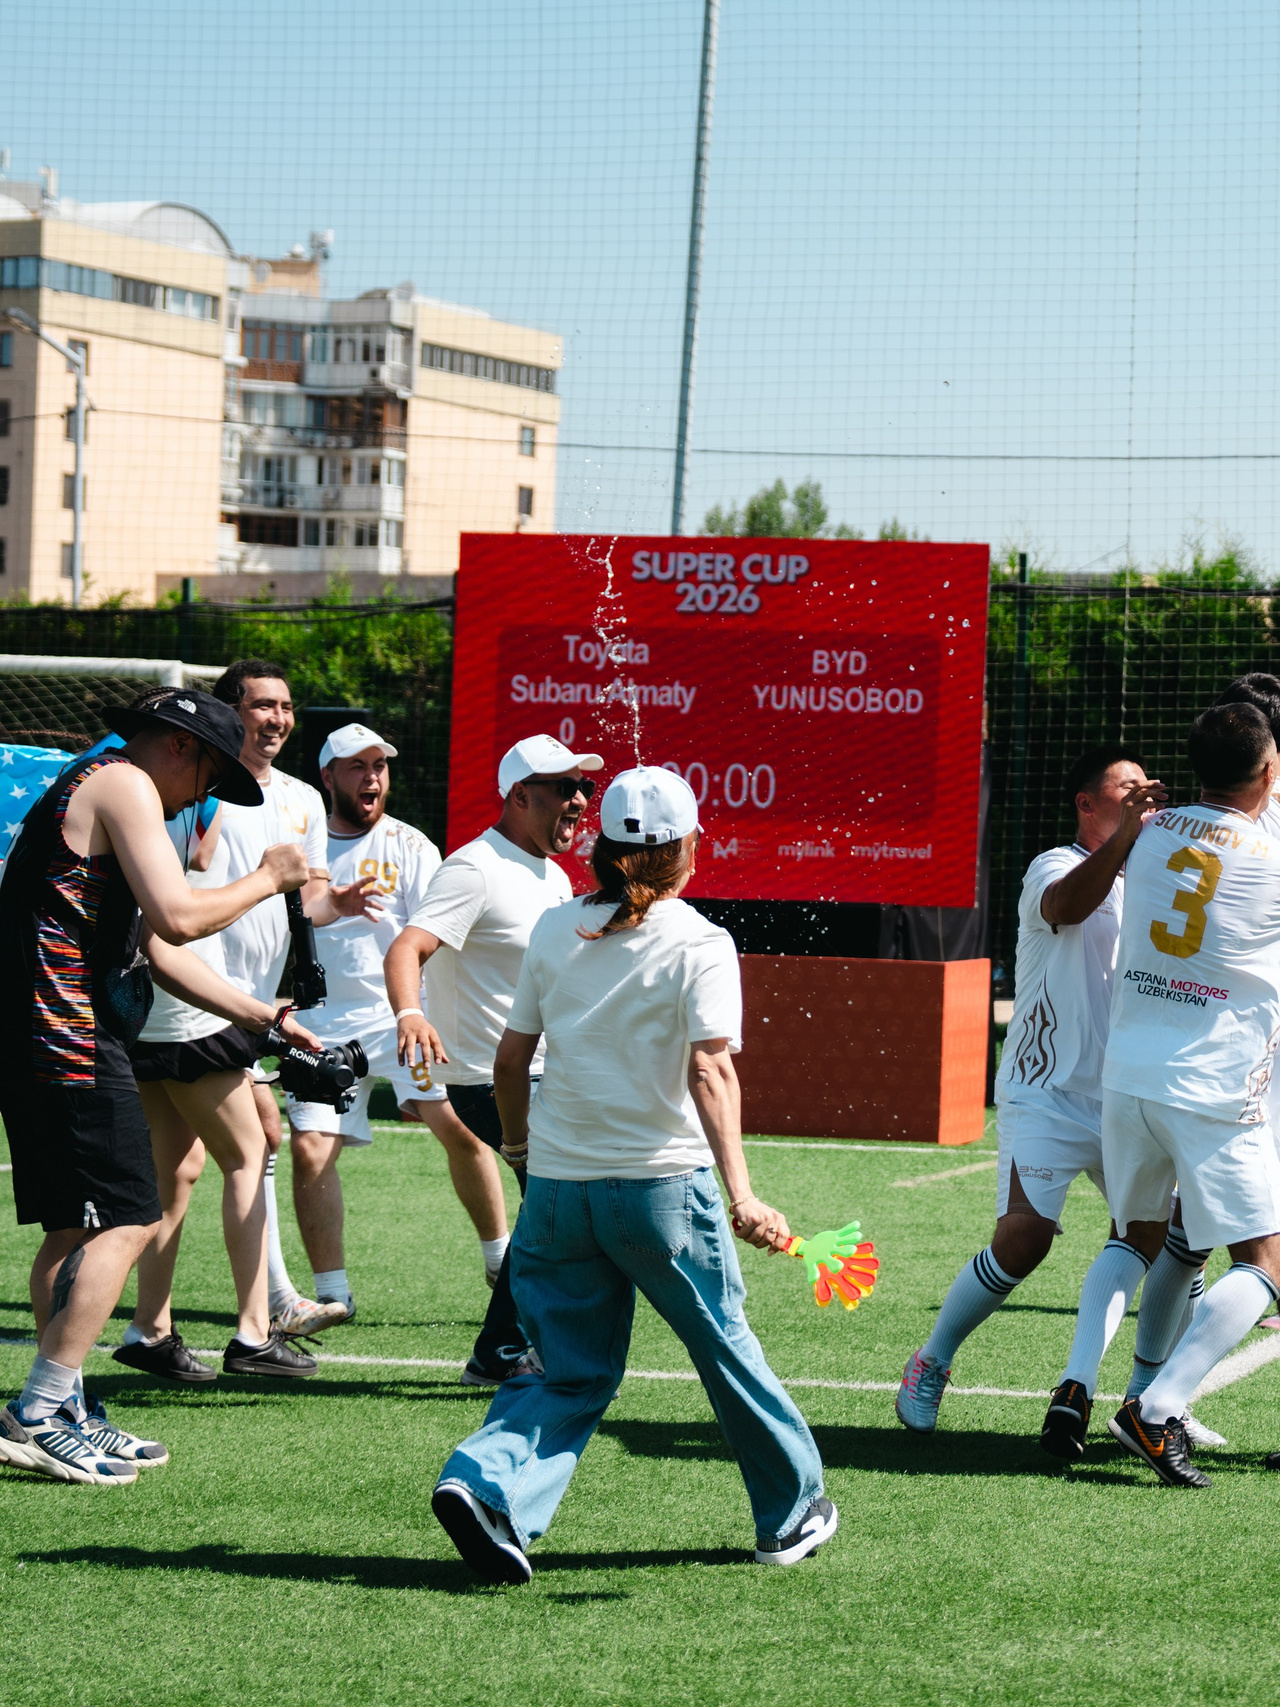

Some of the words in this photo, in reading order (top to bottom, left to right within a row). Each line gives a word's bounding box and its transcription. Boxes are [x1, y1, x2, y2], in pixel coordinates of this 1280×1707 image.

[631, 550, 737, 581] SUPER
[741, 553, 810, 584] CUP
[675, 582, 761, 613] 2026
[563, 634, 650, 670] Toyota
[812, 649, 868, 675] BYD
[510, 673, 602, 704] Subaru
[607, 677, 697, 715] Almaty
[752, 684, 924, 714] YUNUSOBOD
[559, 717, 576, 745] 0
[1155, 811, 1247, 850] SUYUNOV
[1149, 846, 1223, 959] 3
[1123, 969, 1168, 988] ASTANA
[1170, 979, 1230, 1000] MOTORS
[1137, 983, 1208, 1008] UZBEKISTAN
[288, 1046, 320, 1068] RONIN
[1018, 1165, 1054, 1177] BYD
